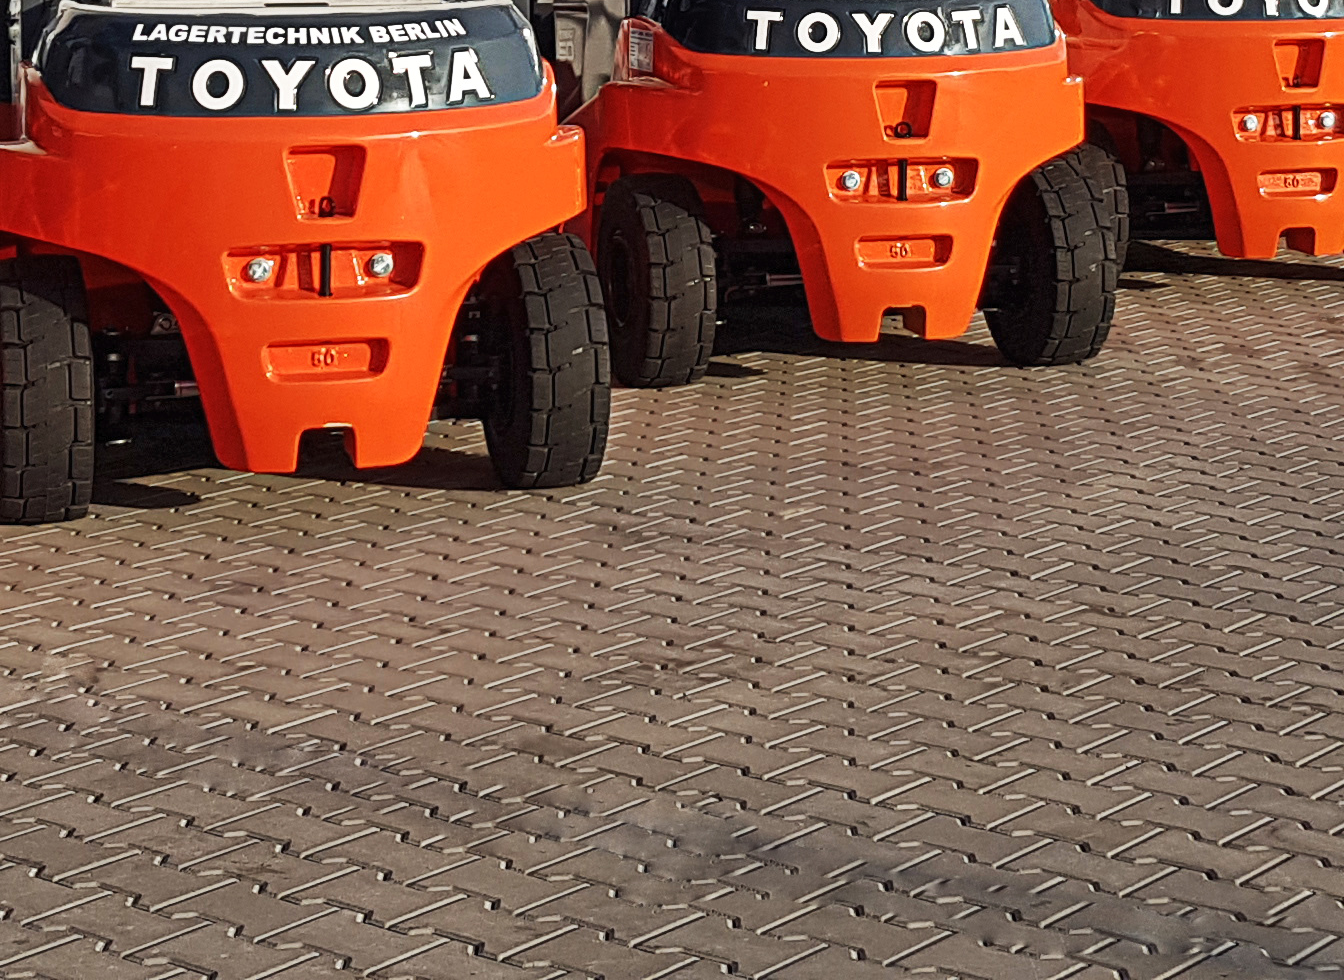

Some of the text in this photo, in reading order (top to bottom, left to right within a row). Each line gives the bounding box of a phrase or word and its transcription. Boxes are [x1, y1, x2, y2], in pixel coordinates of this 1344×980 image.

[131, 18, 467, 45] LAGERTECHNIK BERLIN
[746, 4, 1026, 53] TOYOTA
[130, 47, 496, 112] TOYOTA
